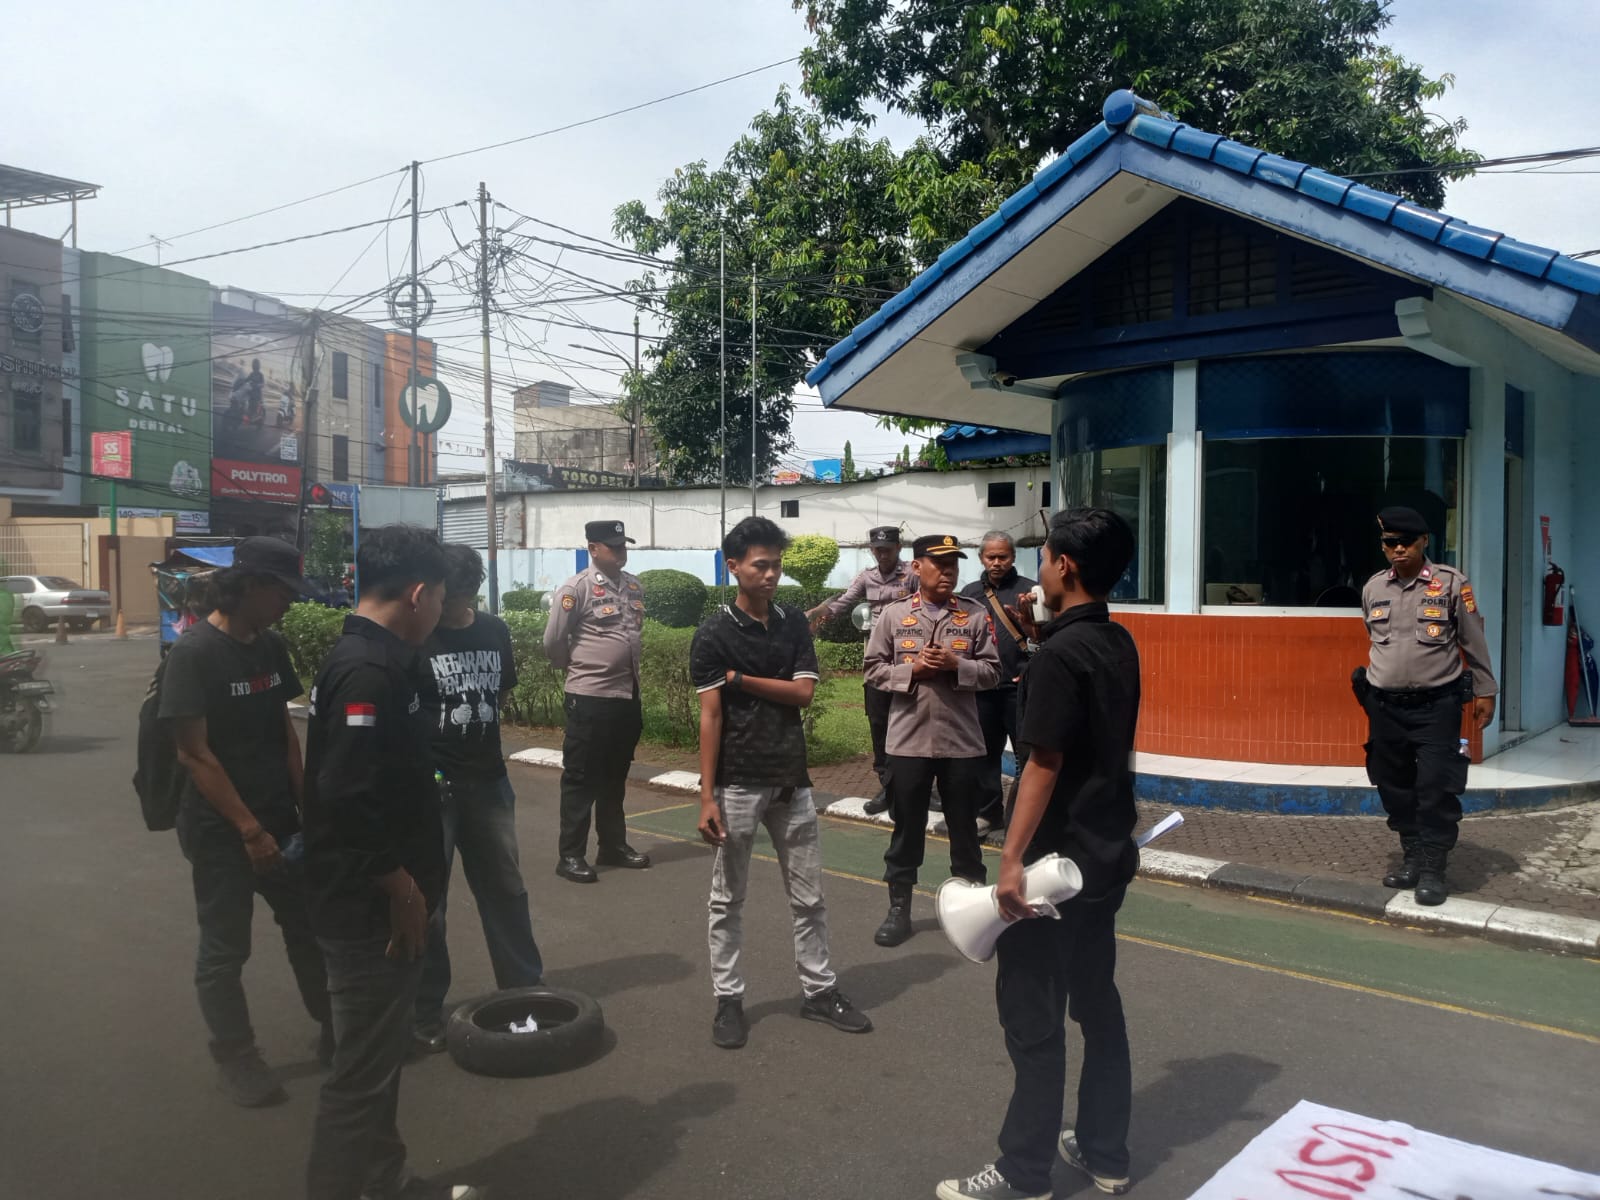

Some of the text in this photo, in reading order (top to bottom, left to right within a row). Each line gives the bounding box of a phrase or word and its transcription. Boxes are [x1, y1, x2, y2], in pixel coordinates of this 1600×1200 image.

[115, 386, 197, 417] SATU
[128, 418, 185, 434] DENTAL
[231, 469, 288, 484] POLYTRON
[561, 470, 598, 485] TOKO
[1421, 598, 1447, 606] POLRI
[946, 628, 971, 637] POLRI
[430, 650, 502, 680] NEGARAKU
[230, 671, 282, 697] INDSIA
[437, 672, 502, 696] PENJARAKU
